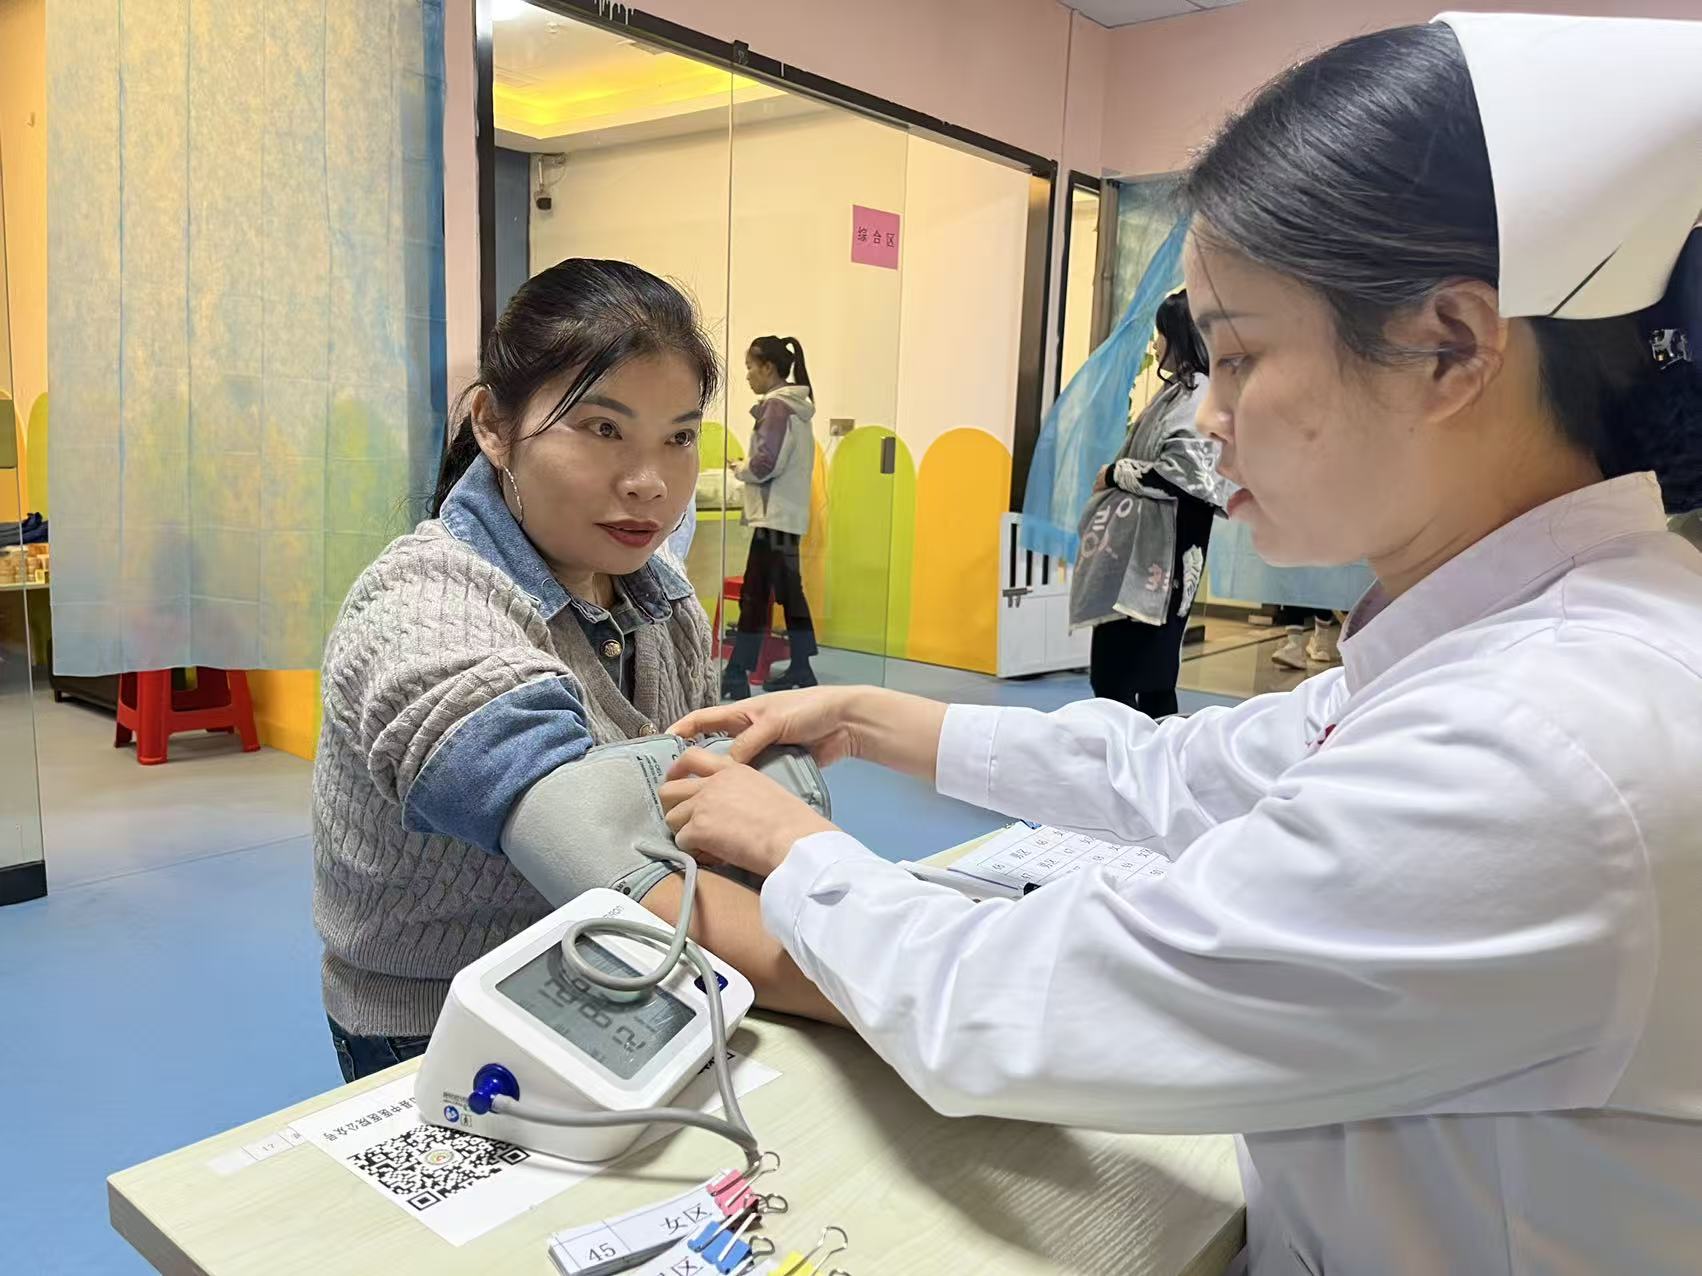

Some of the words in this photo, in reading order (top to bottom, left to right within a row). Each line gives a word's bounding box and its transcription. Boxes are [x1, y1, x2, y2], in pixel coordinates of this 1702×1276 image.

[857, 226, 896, 248] 综合区
[588, 1242, 617, 1262] 45
[660, 1203, 712, 1235] 女区
